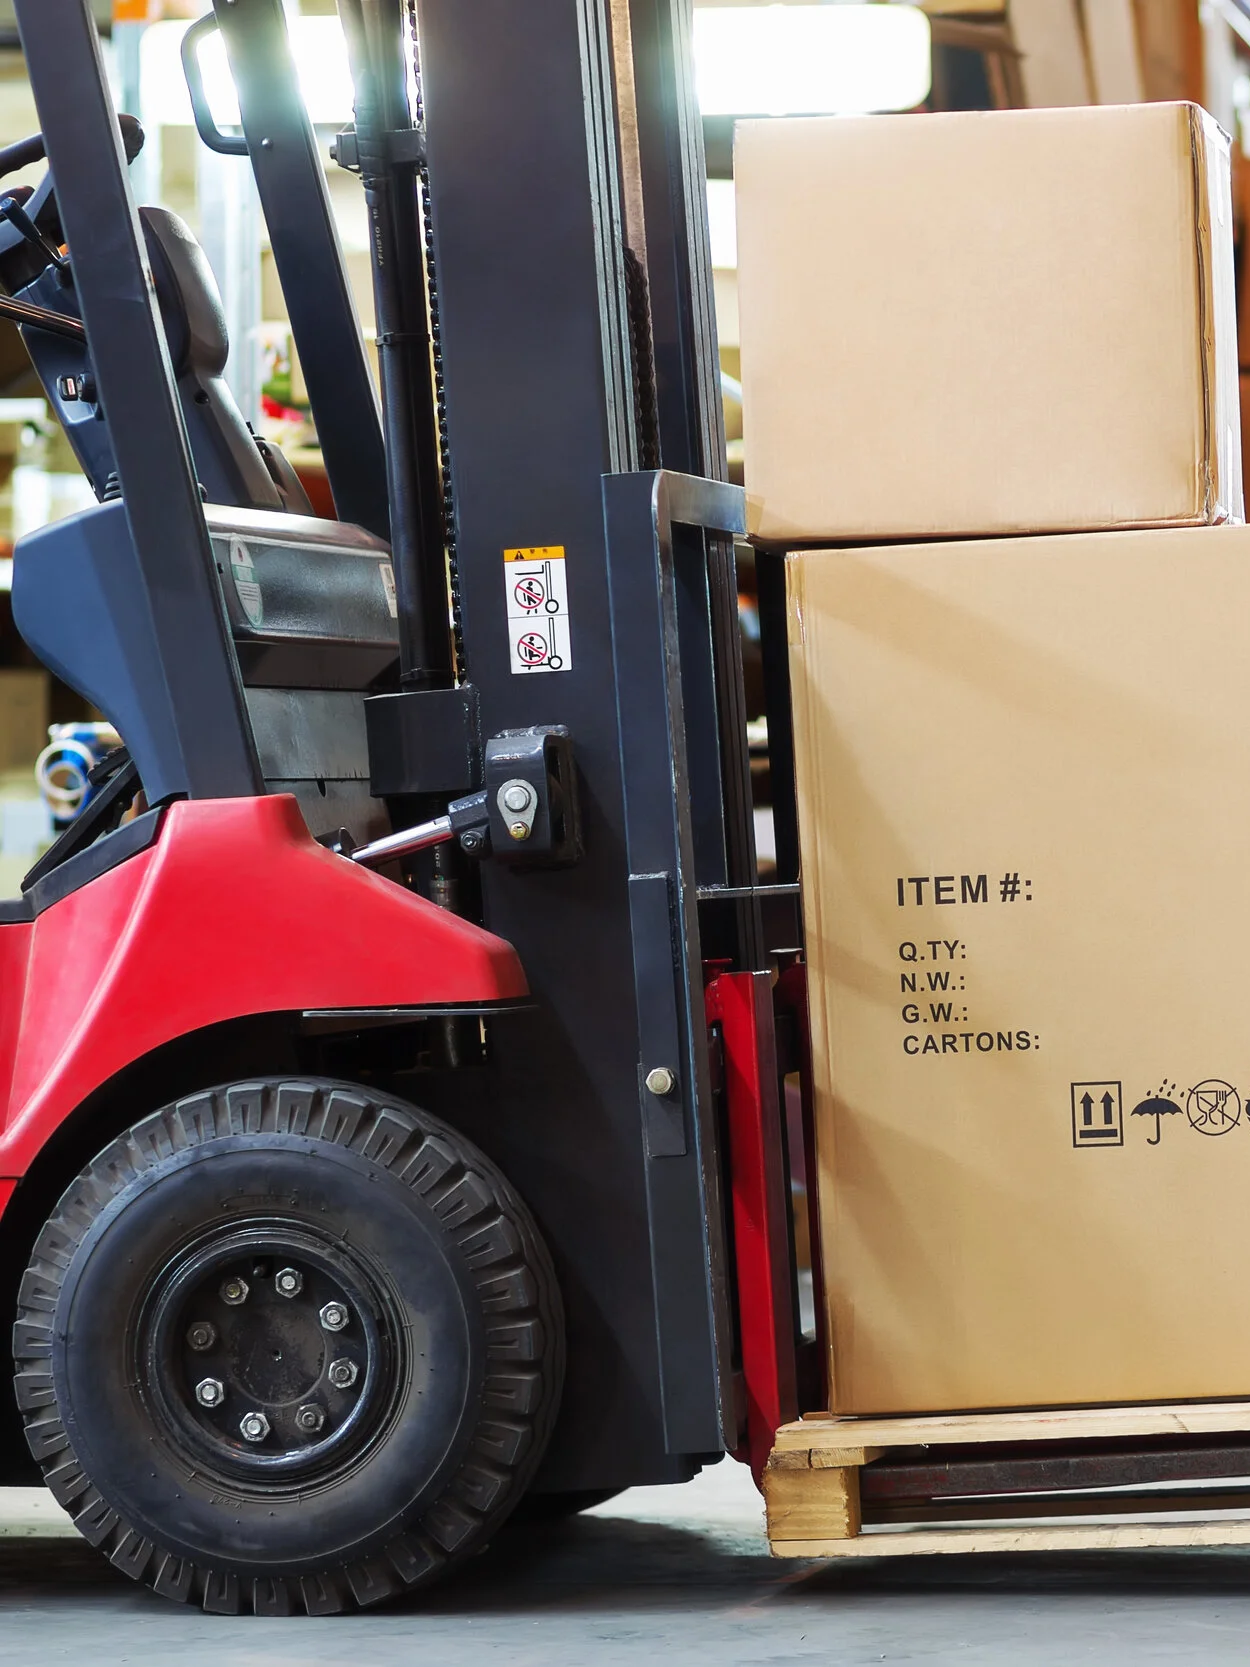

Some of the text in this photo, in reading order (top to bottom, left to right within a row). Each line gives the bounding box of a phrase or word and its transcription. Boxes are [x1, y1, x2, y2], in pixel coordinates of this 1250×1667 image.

[897, 872, 1032, 907] ITEM #:
[898, 940, 966, 962] Q.TY:
[900, 971, 965, 993] N.W.:
[901, 1002, 968, 1024] G.W.:
[903, 1030, 1040, 1055] CARTONS:
